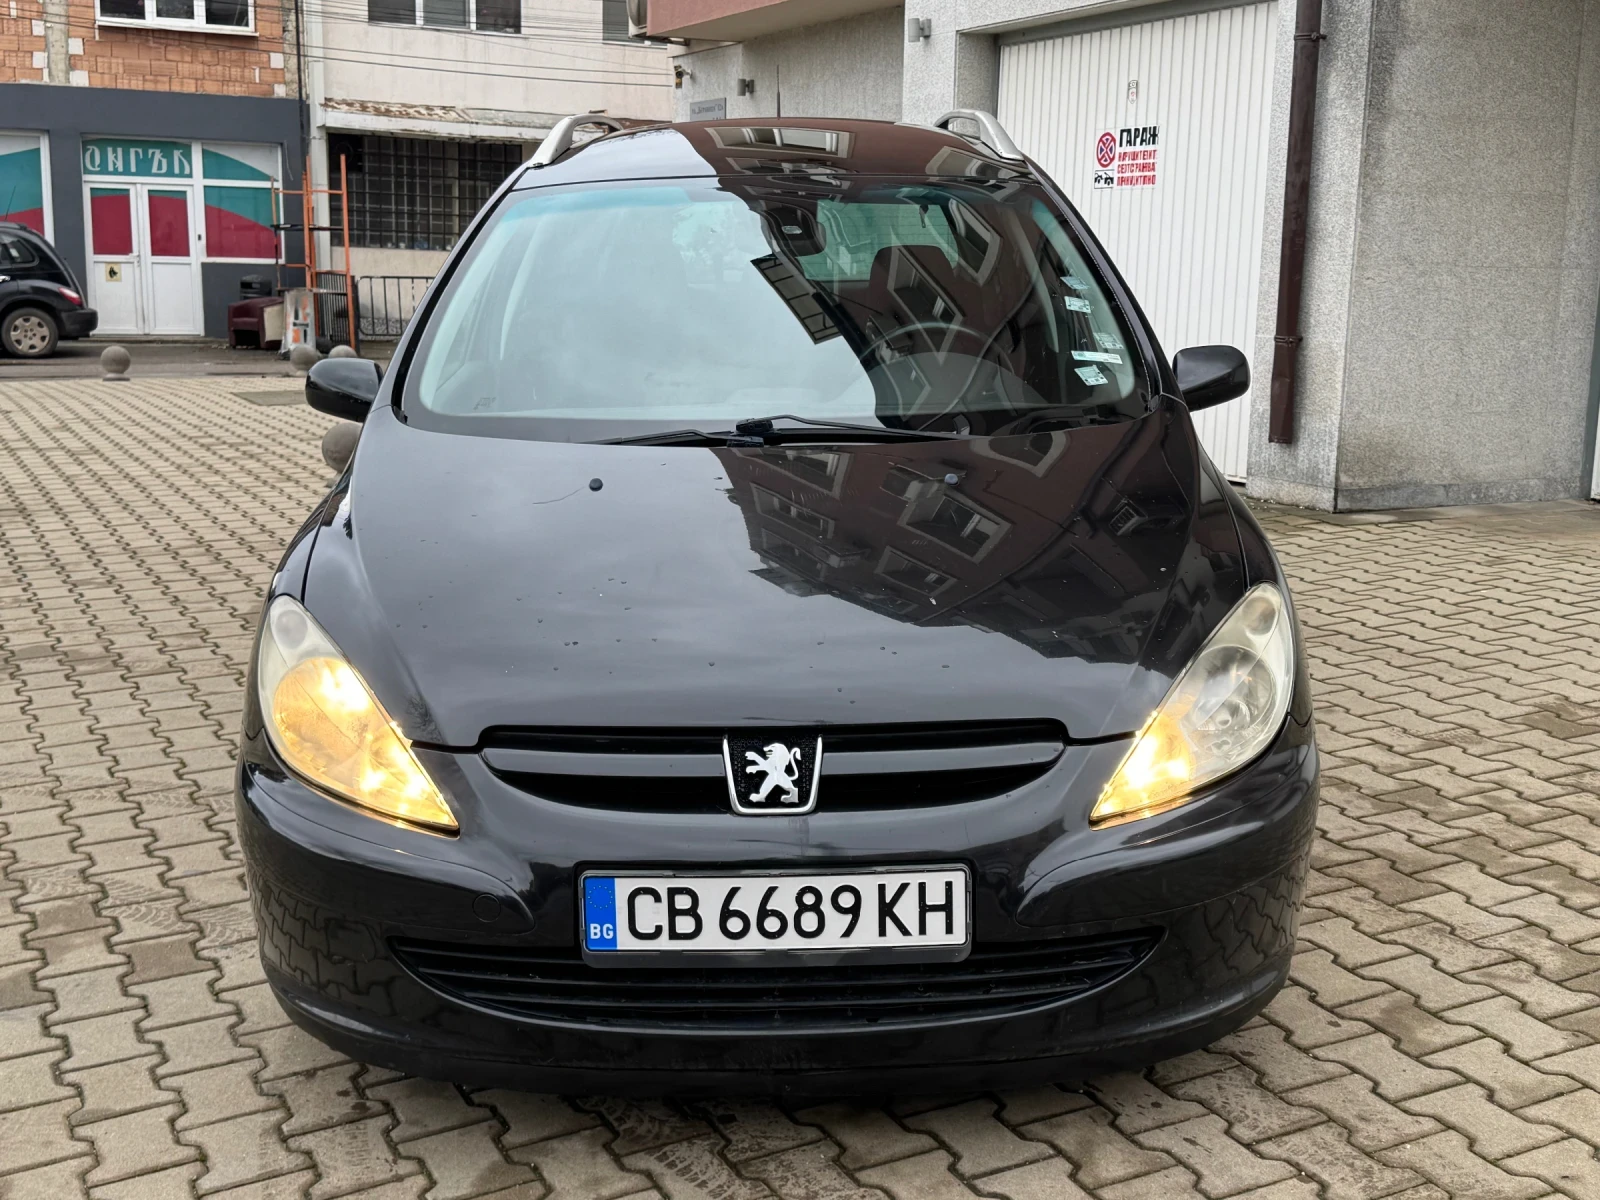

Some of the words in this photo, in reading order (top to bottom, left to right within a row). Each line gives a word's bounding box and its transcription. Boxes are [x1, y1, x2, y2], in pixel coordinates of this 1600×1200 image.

[1119, 126, 1159, 147] ГАРАЖ
[627, 886, 702, 940] CB
[719, 884, 862, 940] 6689
[878, 881, 954, 938] KH
[590, 923, 614, 940] BG
